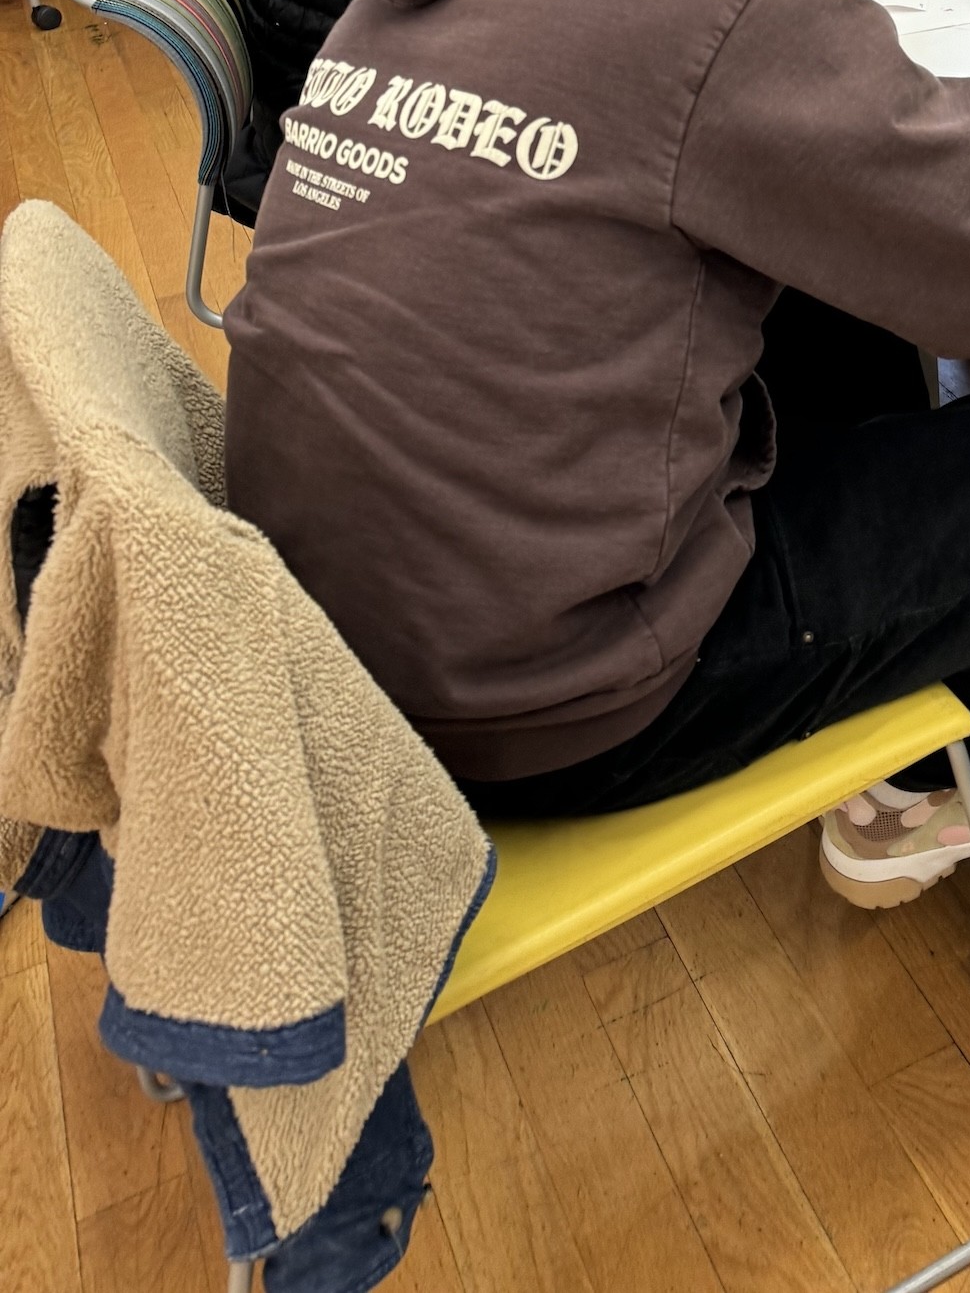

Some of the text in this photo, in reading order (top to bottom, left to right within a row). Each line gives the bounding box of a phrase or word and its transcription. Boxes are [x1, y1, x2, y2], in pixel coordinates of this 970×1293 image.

[285, 117, 409, 184] BARRIO GOODS
[321, 175, 356, 199] STREETS
[355, 188, 371, 203] OF
